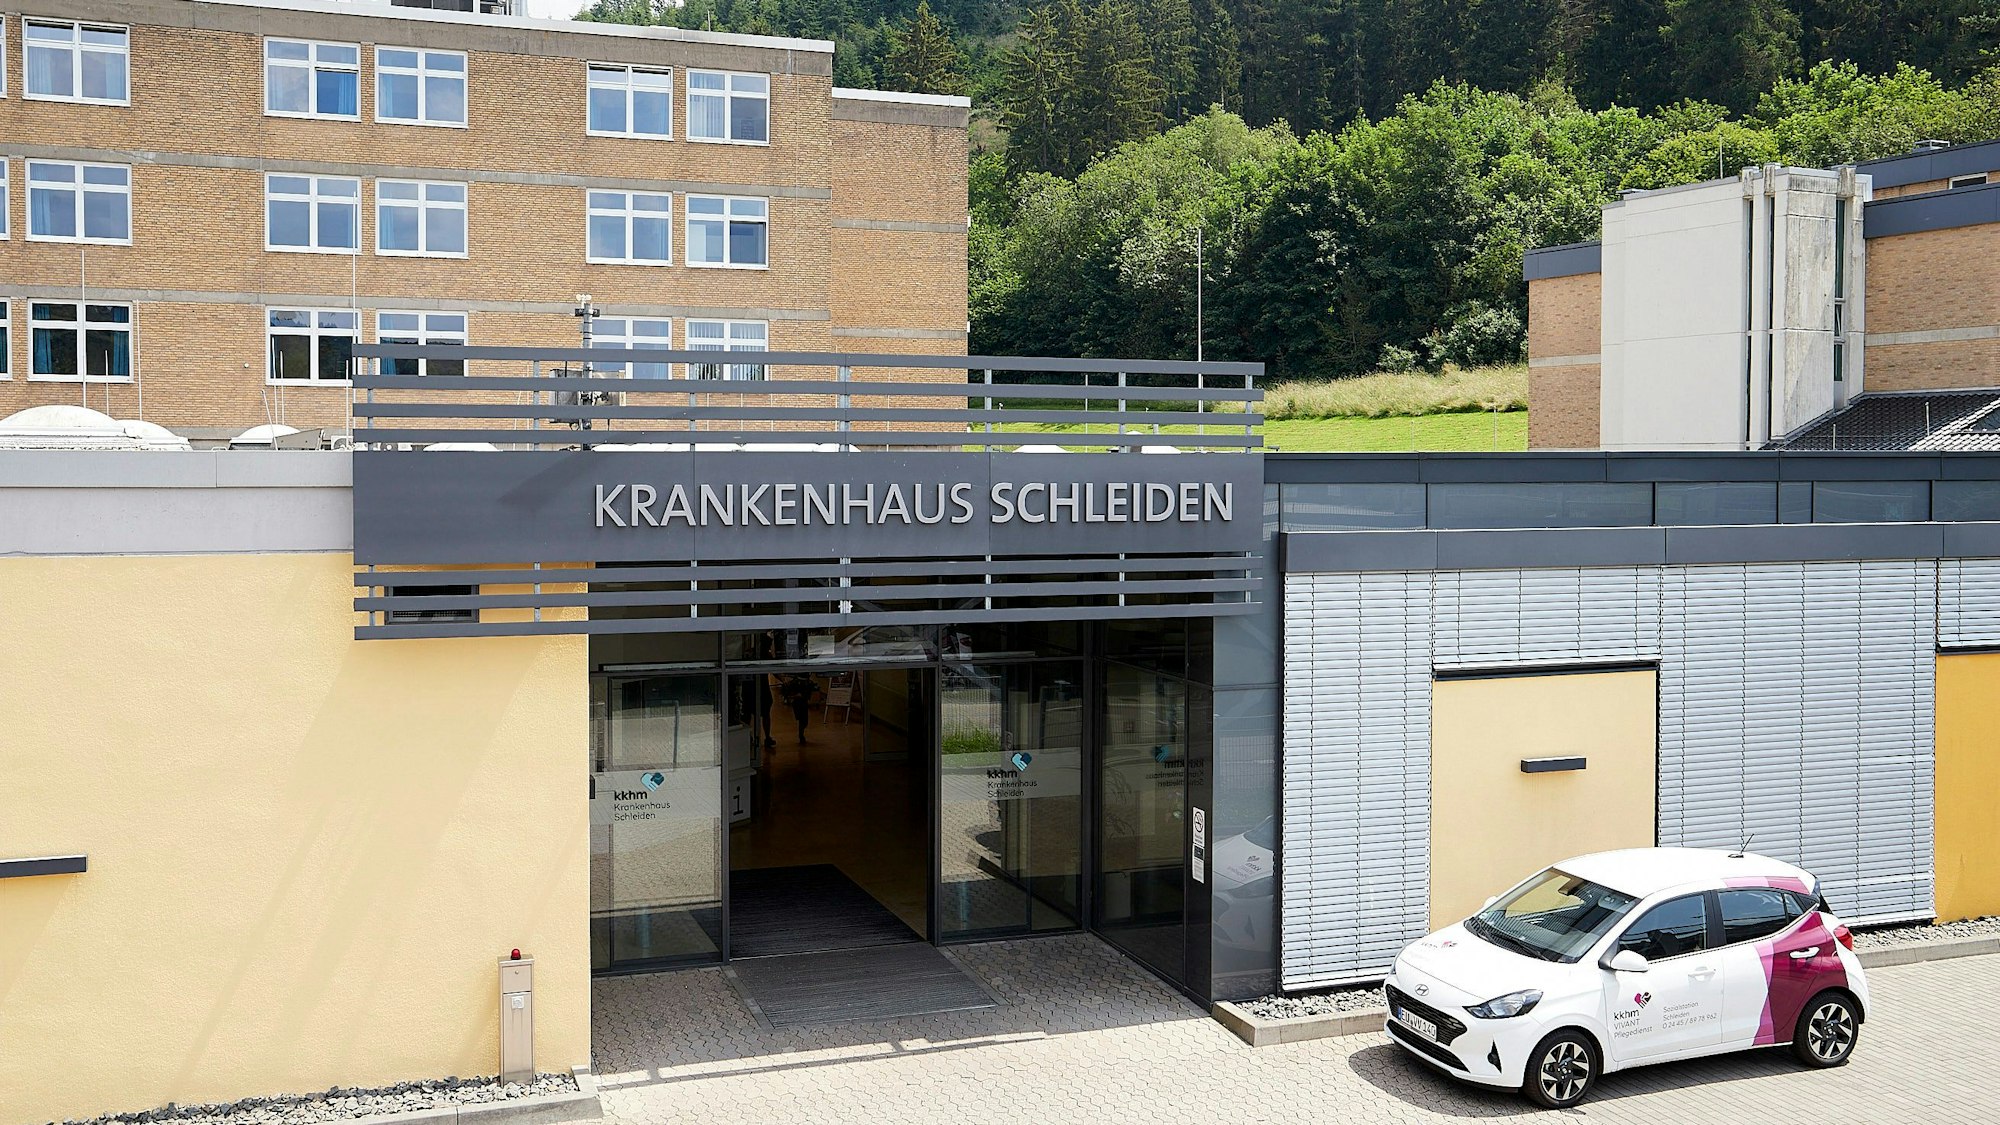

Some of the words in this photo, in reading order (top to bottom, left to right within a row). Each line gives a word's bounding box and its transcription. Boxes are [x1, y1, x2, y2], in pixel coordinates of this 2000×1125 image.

[595, 482, 975, 528] KRANKENHAUS
[990, 481, 1234, 525] SCHLEIDEN
[987, 768, 1018, 779] kkhm
[987, 779, 1038, 789] Krankenhaus
[614, 790, 648, 801] kkhm
[987, 789, 1025, 798] Schleiden
[614, 801, 671, 811] Krankenhaus
[614, 812, 656, 821] Schleiden
[1613, 1009, 1640, 1021] kkhm
[1613, 1018, 1640, 1030] VIVANT
[1614, 1026, 1653, 1039] Pflegedienst
